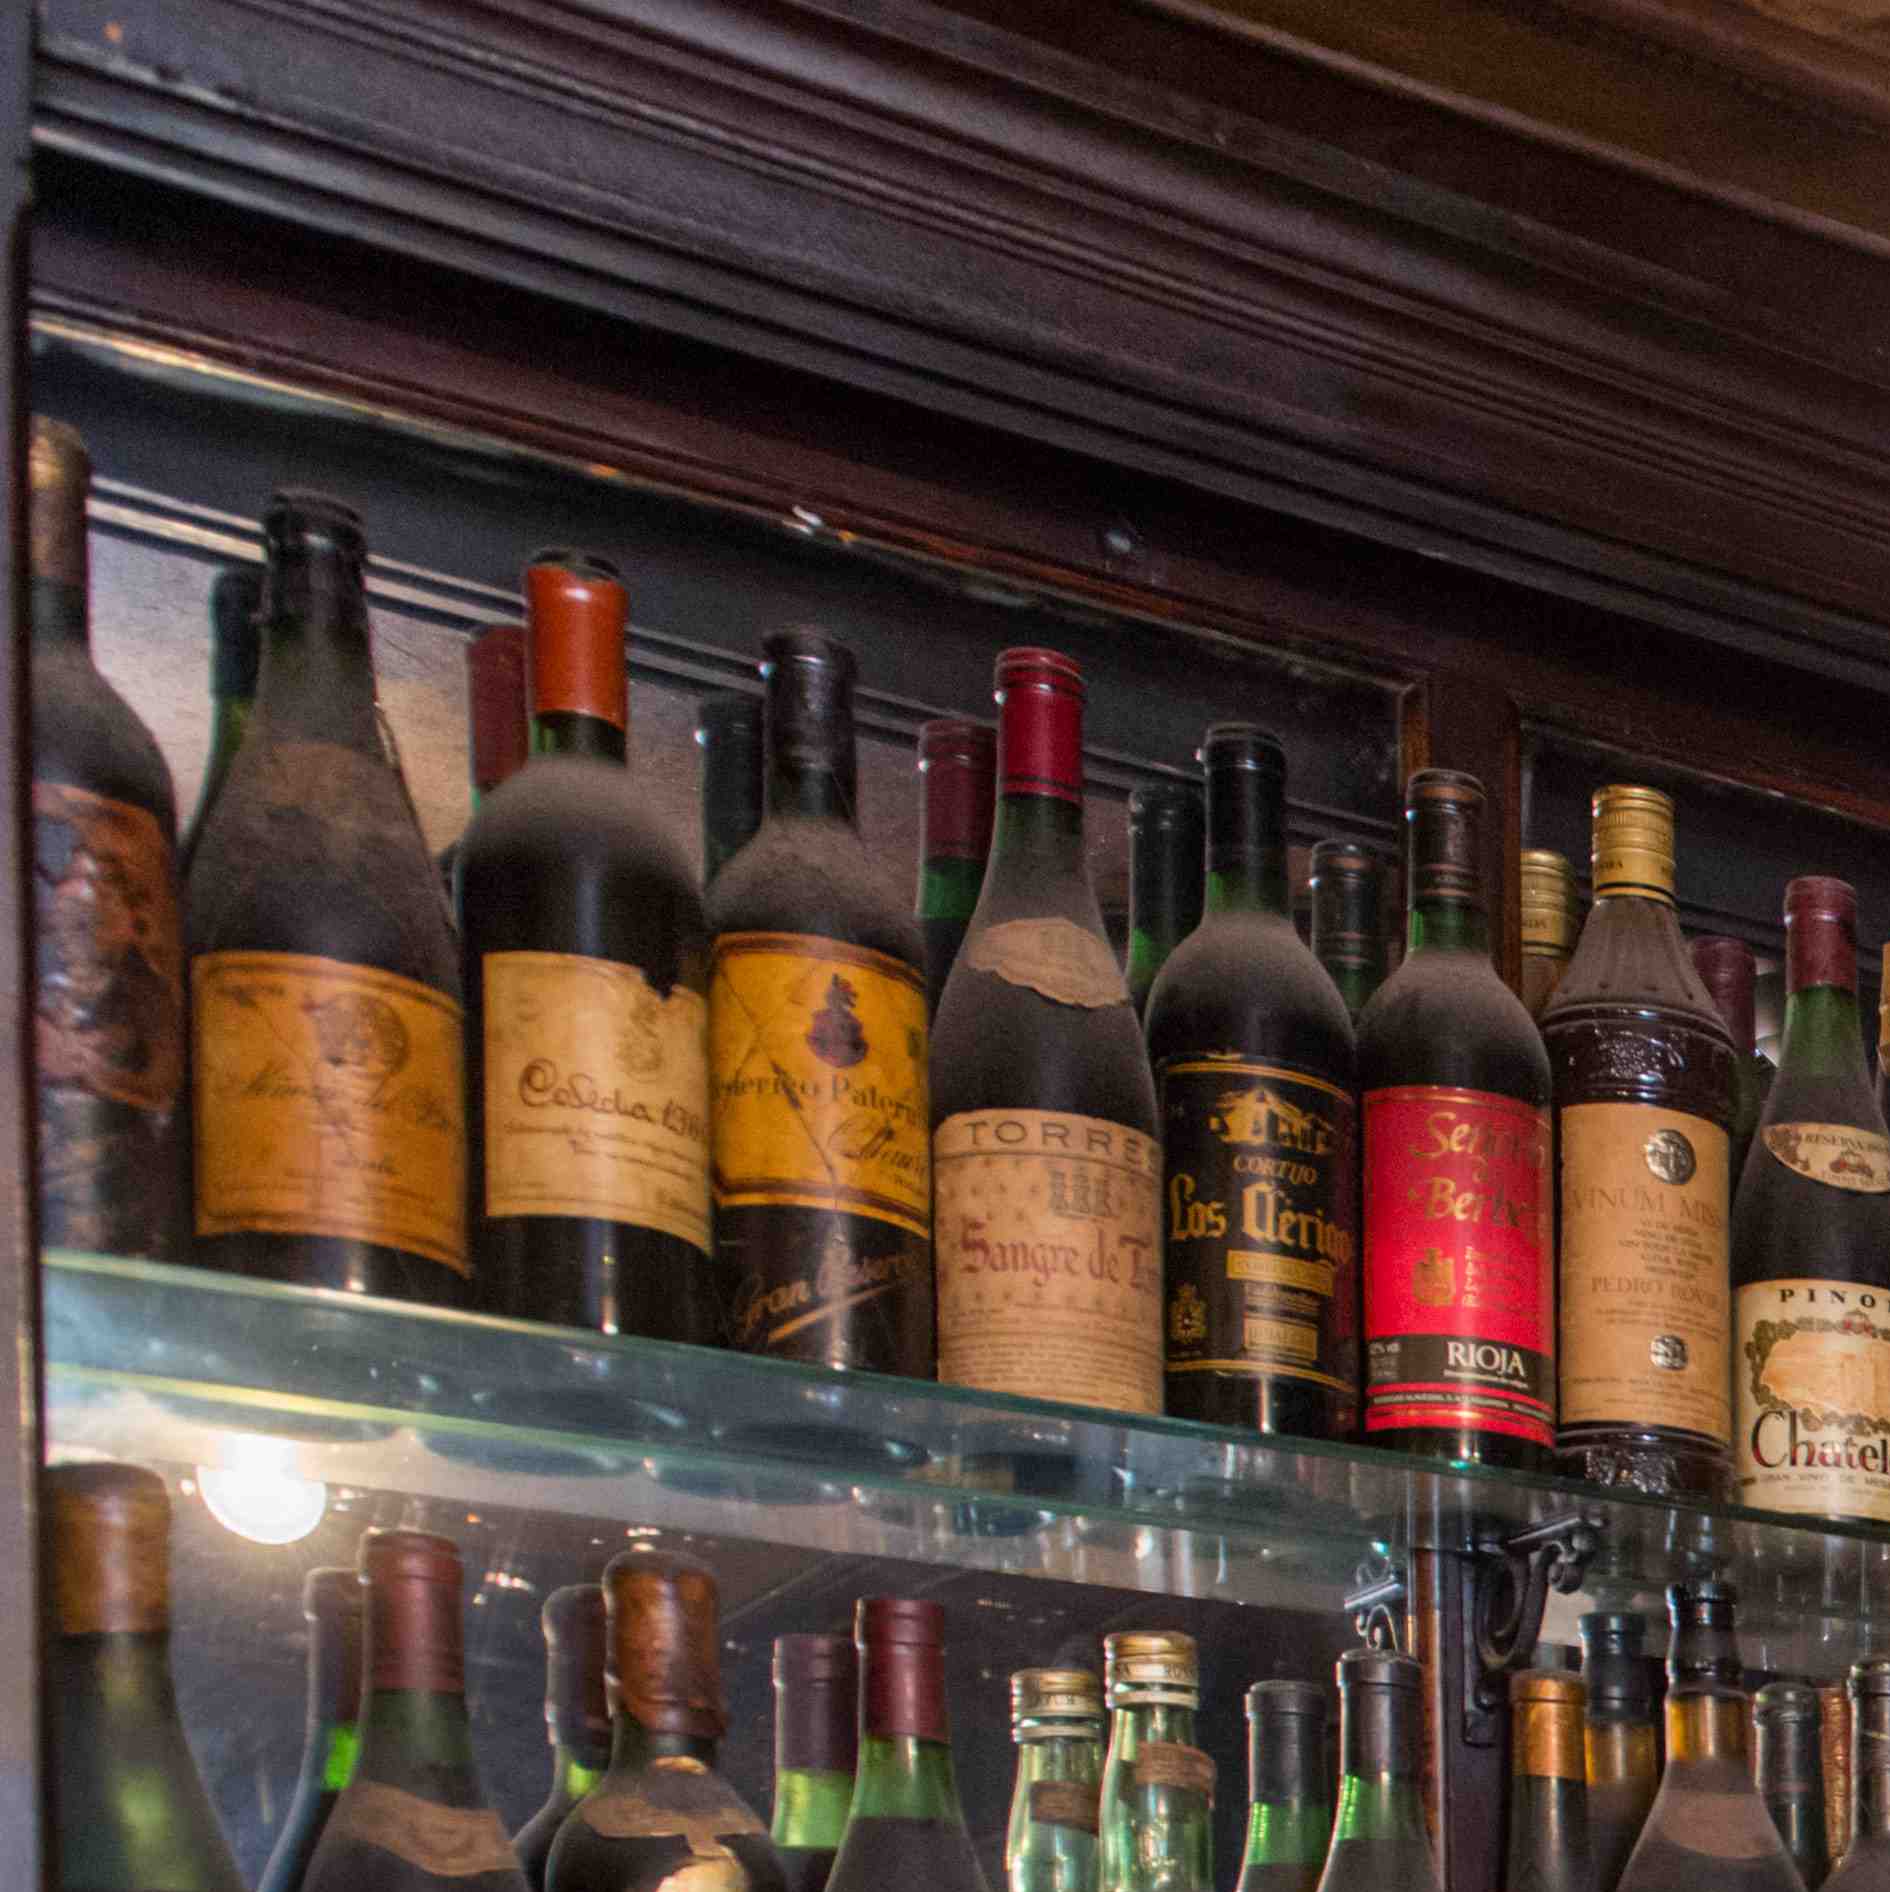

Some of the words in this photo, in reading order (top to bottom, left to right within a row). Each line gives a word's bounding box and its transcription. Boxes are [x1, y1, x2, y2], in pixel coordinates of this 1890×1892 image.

[1170, 1173, 1227, 1241] Los
[959, 1218, 1082, 1288] Sangre
[1088, 1221, 1119, 1283] de
[1447, 1341, 1527, 1378] RIOJA
